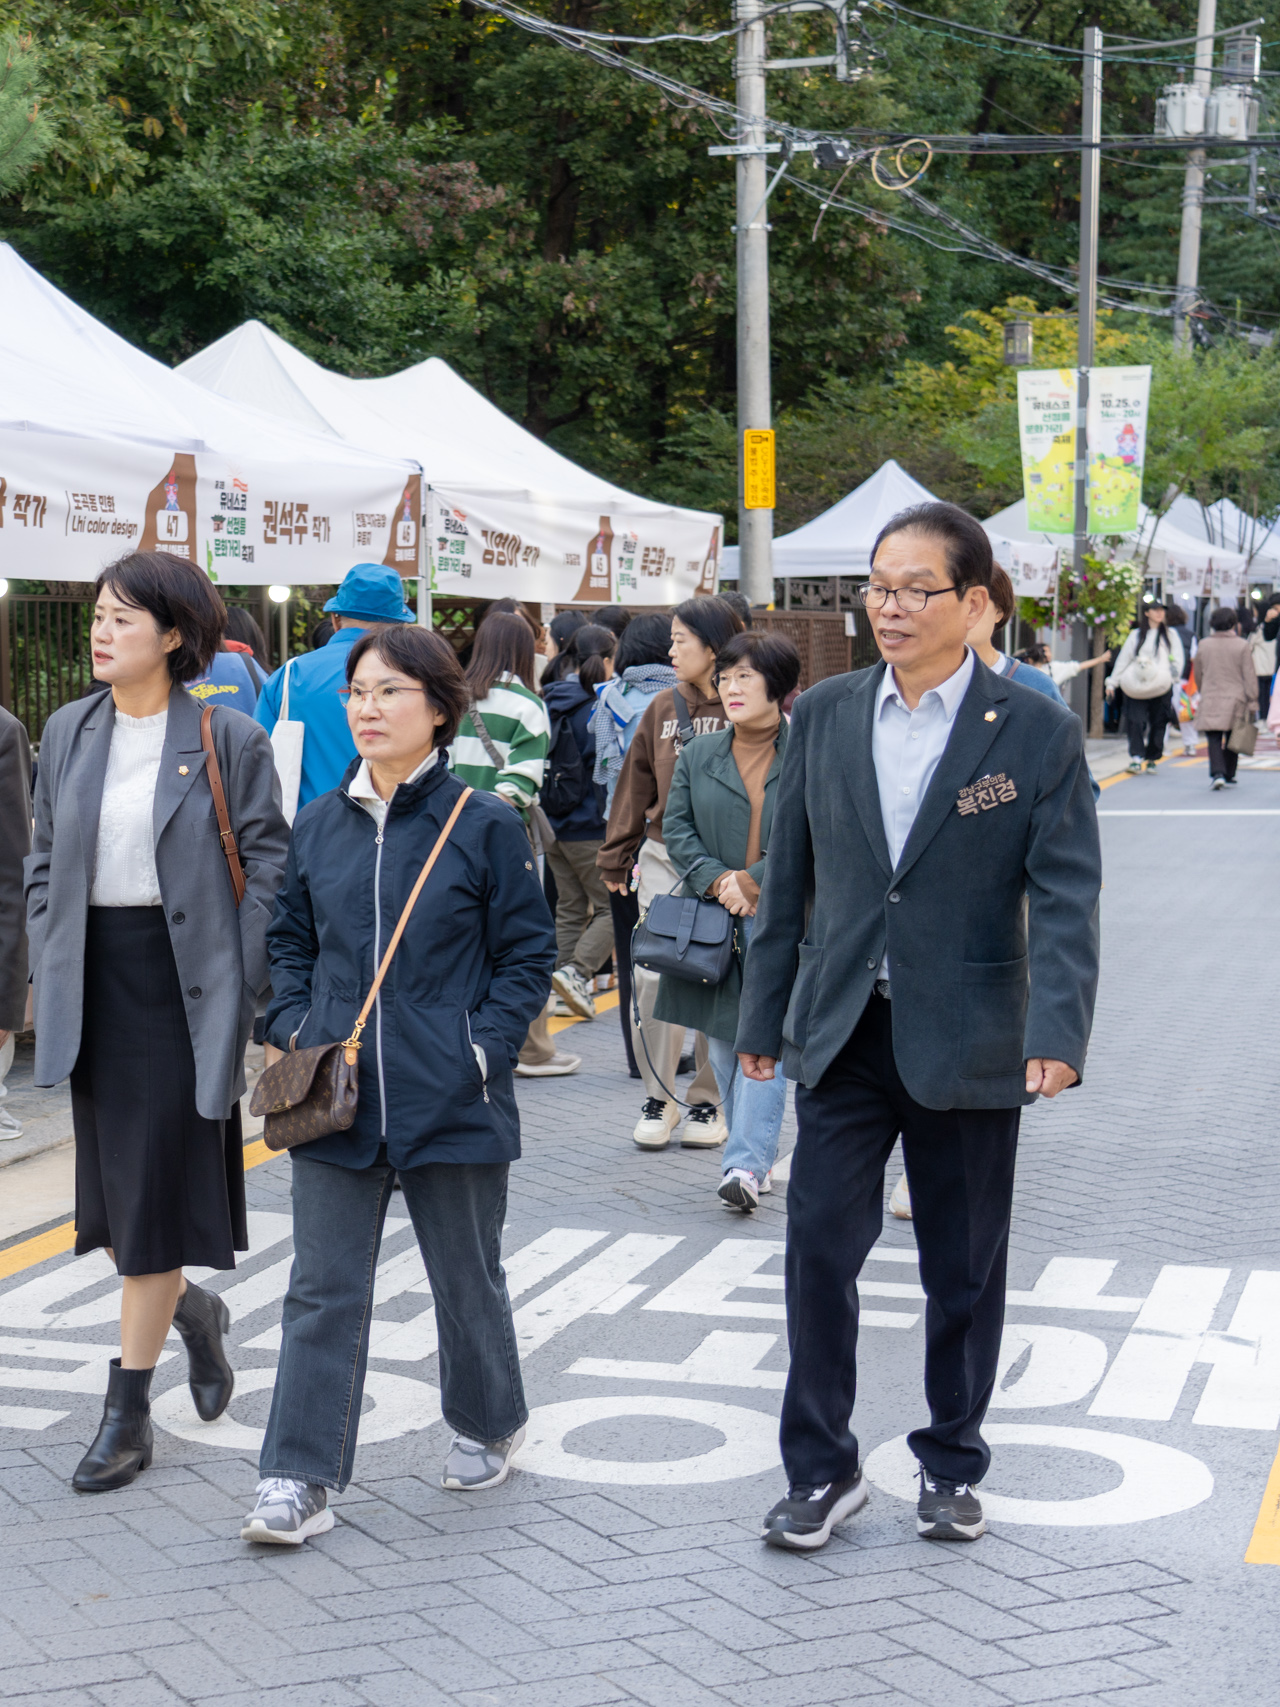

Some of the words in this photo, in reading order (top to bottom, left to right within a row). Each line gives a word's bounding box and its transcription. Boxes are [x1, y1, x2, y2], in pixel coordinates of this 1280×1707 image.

[13, 494, 47, 528] 작가
[72, 493, 98, 512] 도곡동
[98, 495, 115, 513] 민화
[220, 492, 247, 511] 유네스코
[87, 516, 110, 534] color
[111, 518, 138, 539] design
[166, 515, 179, 537] 47
[227, 517, 246, 535] 선정릉
[263, 500, 309, 545] 권석주
[312, 516, 331, 543] 작가
[215, 539, 240, 557] 문화거리
[958, 772, 1007, 798] 강남구부의장
[957, 779, 1018, 816] 복진경
